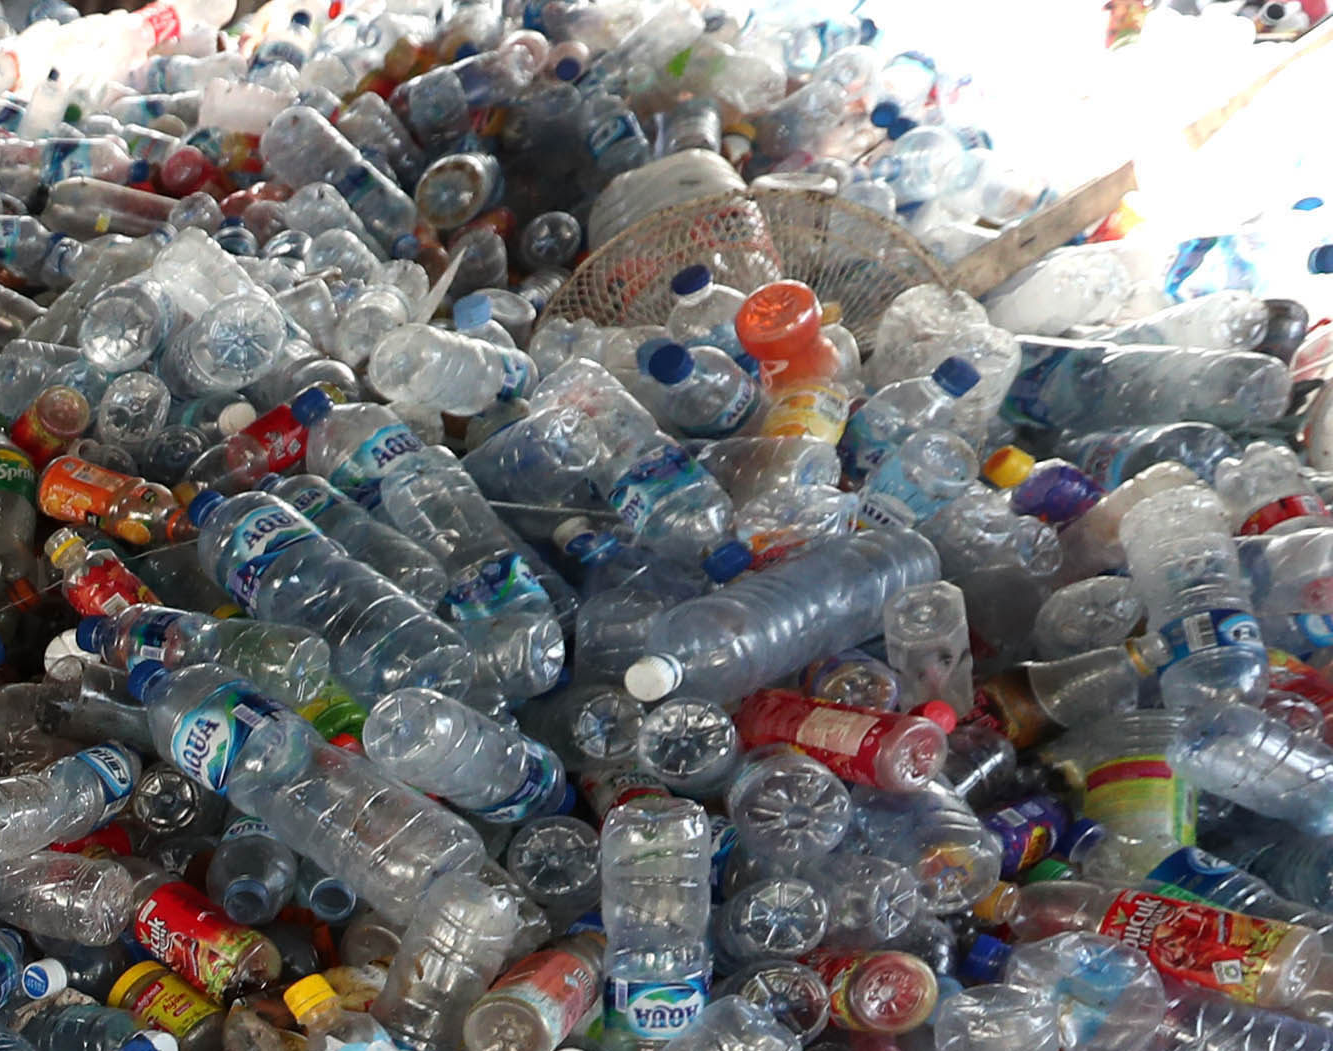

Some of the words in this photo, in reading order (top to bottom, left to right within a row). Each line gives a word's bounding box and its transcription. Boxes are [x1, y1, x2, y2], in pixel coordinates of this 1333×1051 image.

[190, 713, 220, 779] AQUA
[89, 747, 127, 785] prim-a
[633, 1002, 701, 1030] AQUA
